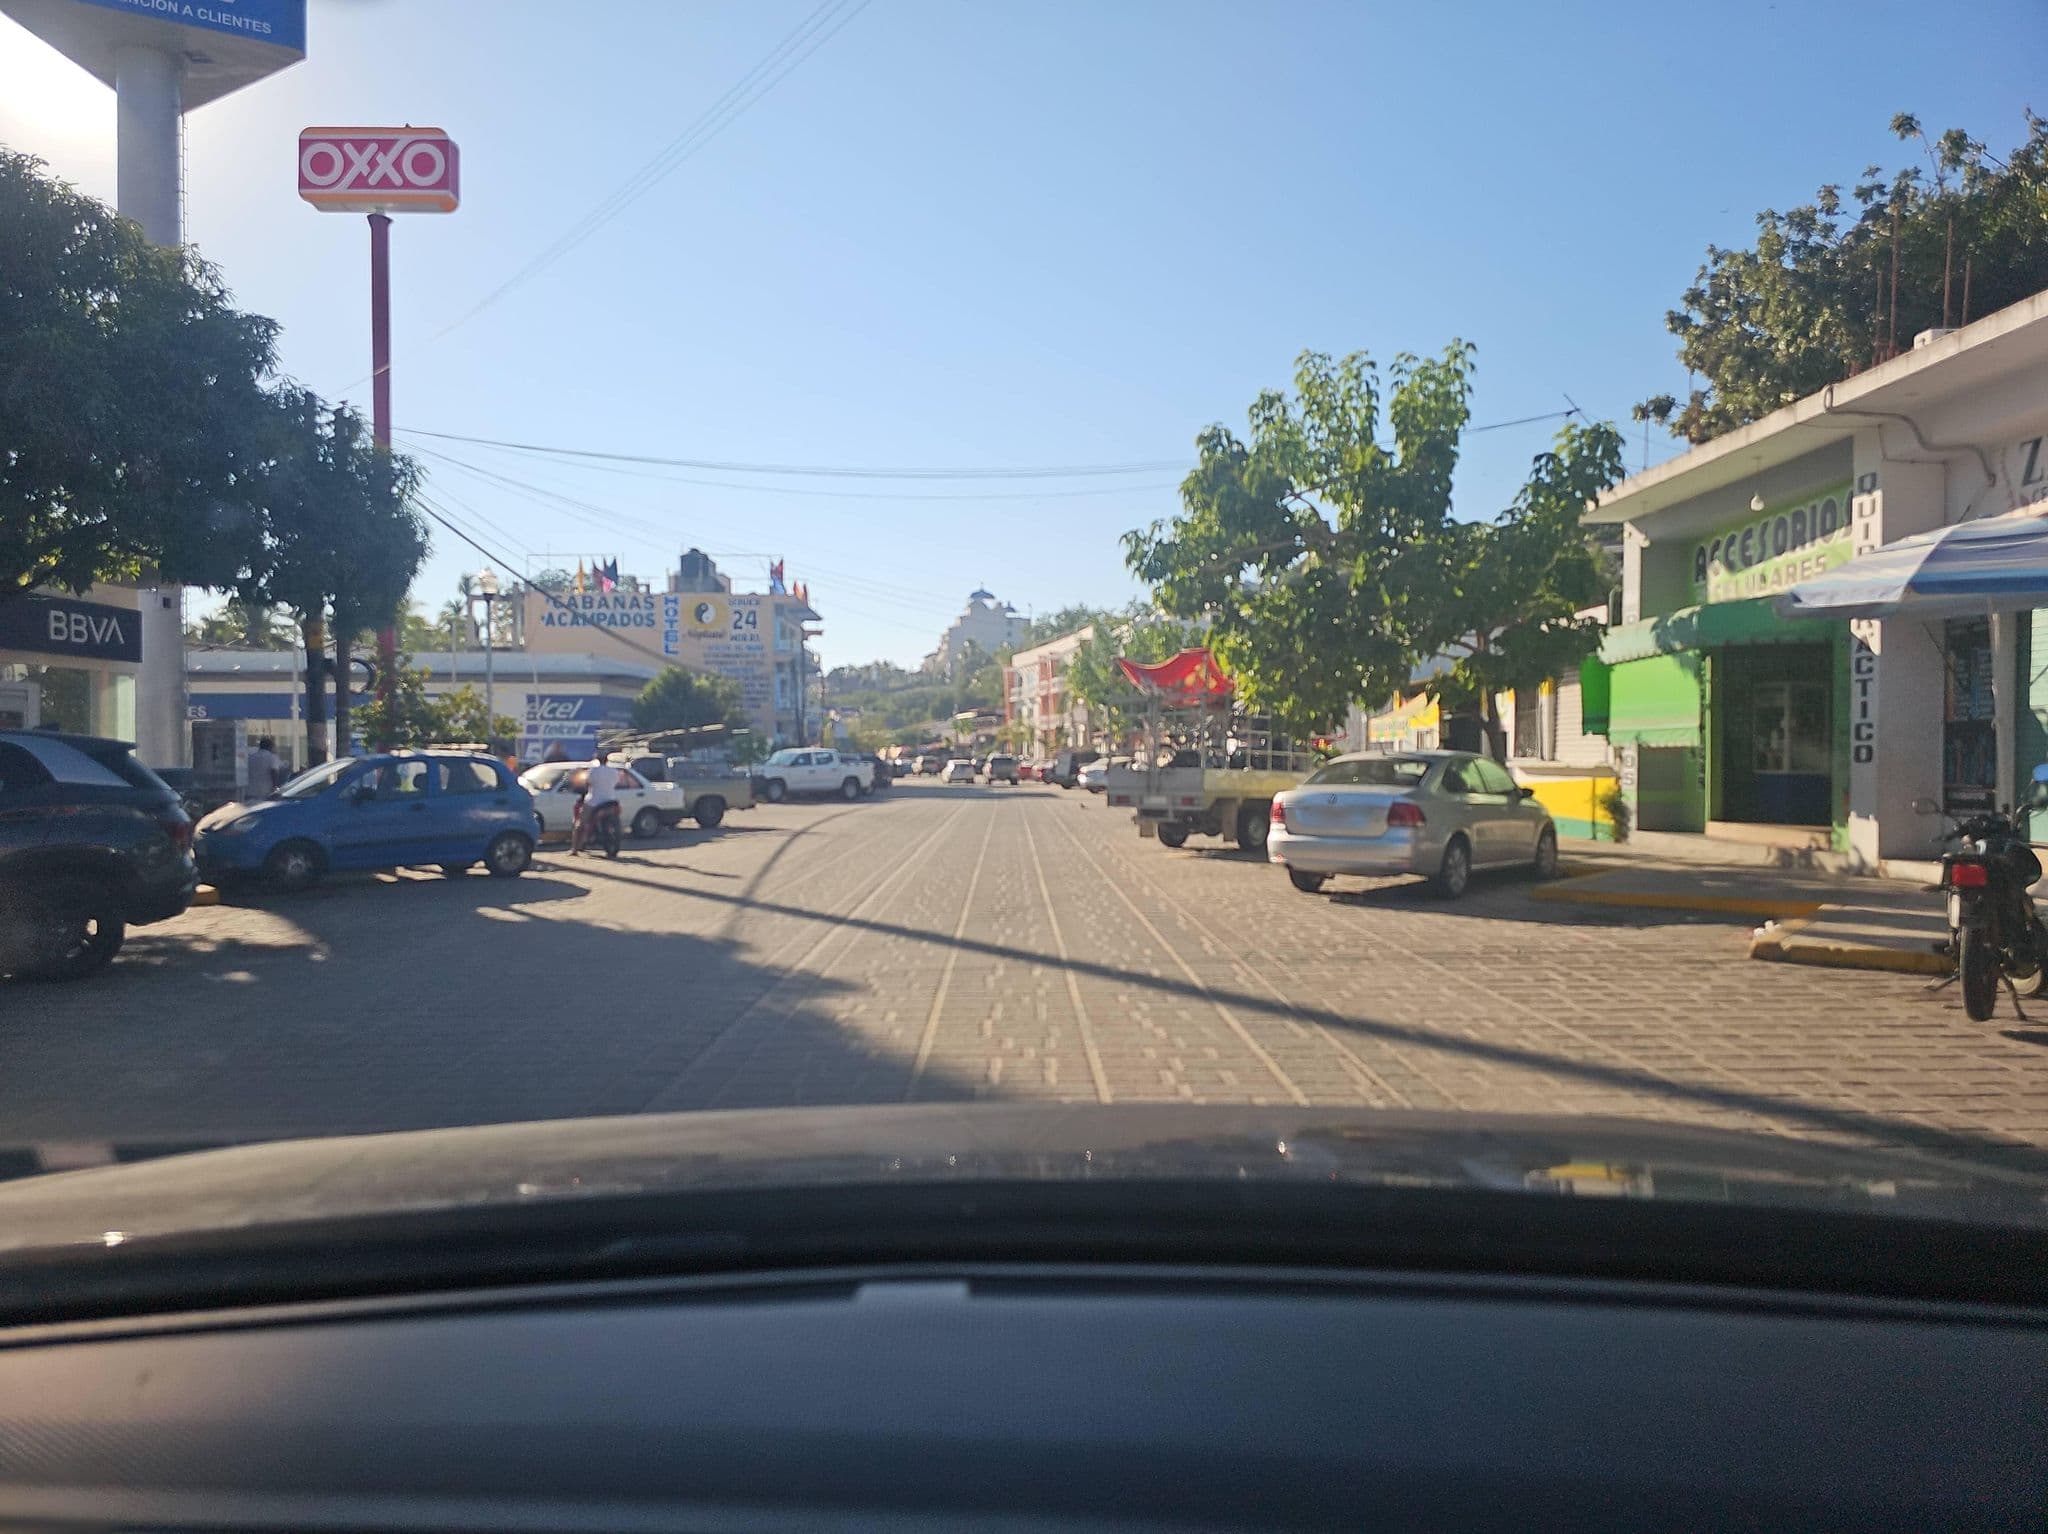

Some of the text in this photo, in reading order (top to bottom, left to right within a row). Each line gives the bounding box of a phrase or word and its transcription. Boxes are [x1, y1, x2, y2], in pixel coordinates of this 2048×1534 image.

[182, 7, 194, 17] A
[197, 8, 272, 35] CLIENTES
[302, 142, 446, 188] OXXO
[49, 609, 125, 644] BBVA
[664, 596, 679, 656] HOTEL
[733, 610, 758, 630] 24
